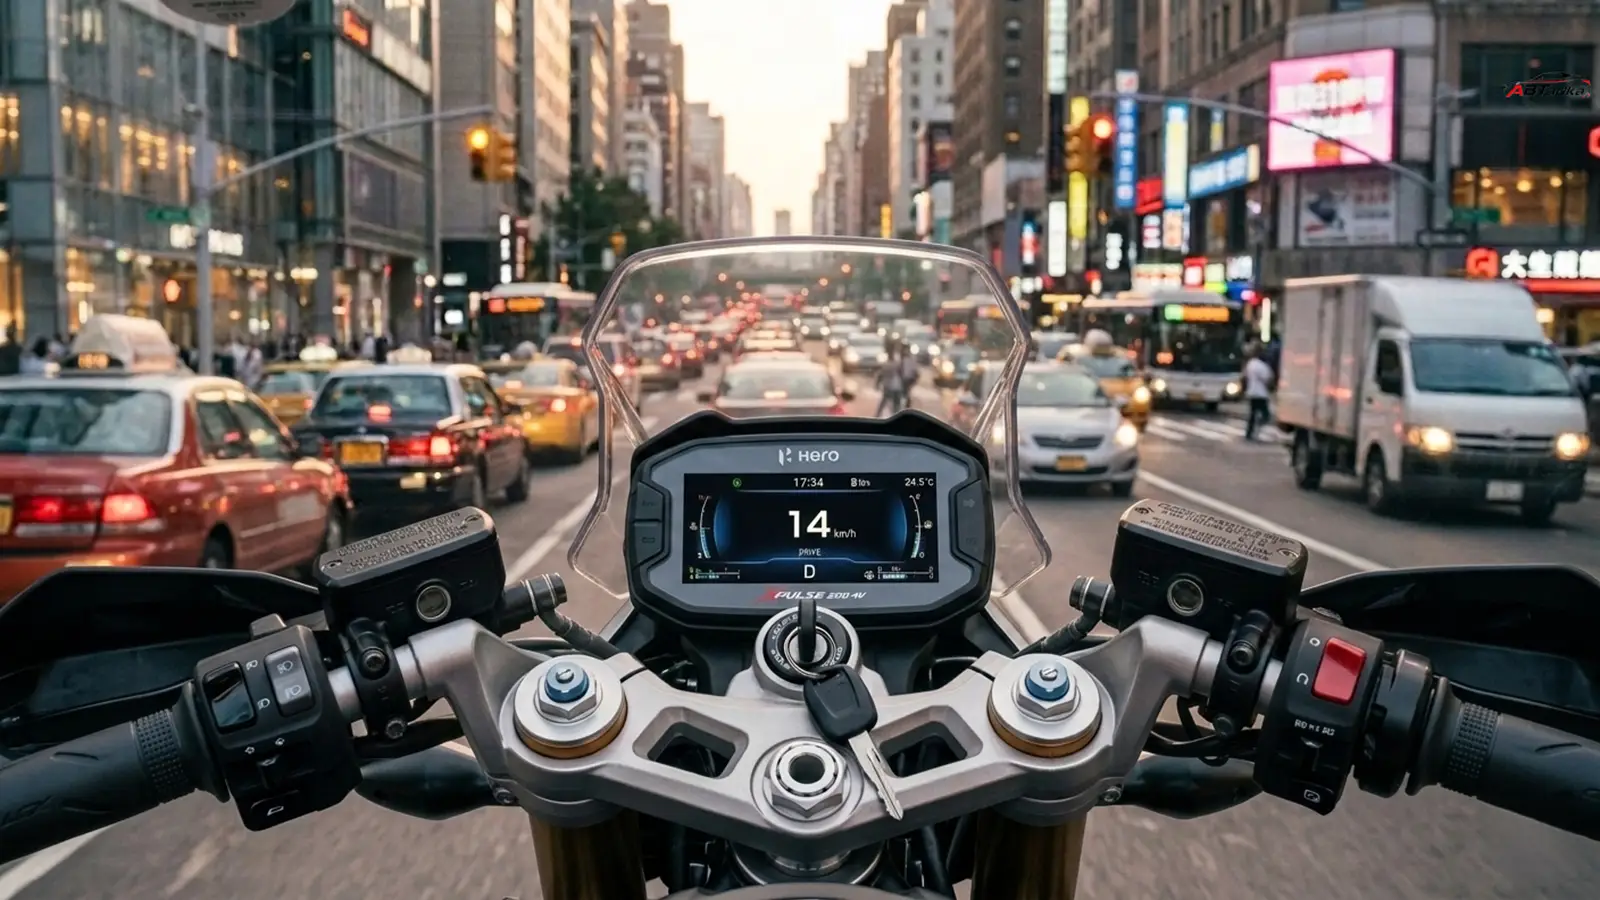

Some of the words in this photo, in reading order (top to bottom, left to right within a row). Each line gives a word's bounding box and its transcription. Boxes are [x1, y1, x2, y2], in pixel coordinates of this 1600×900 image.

[798, 450, 839, 462] Hero
[793, 477, 824, 487] 17:34
[904, 477, 935, 487] 24.5°C
[788, 510, 831, 538] 14
[833, 528, 857, 538] km/h
[798, 547, 822, 557] DRIVE
[803, 563, 816, 579] D
